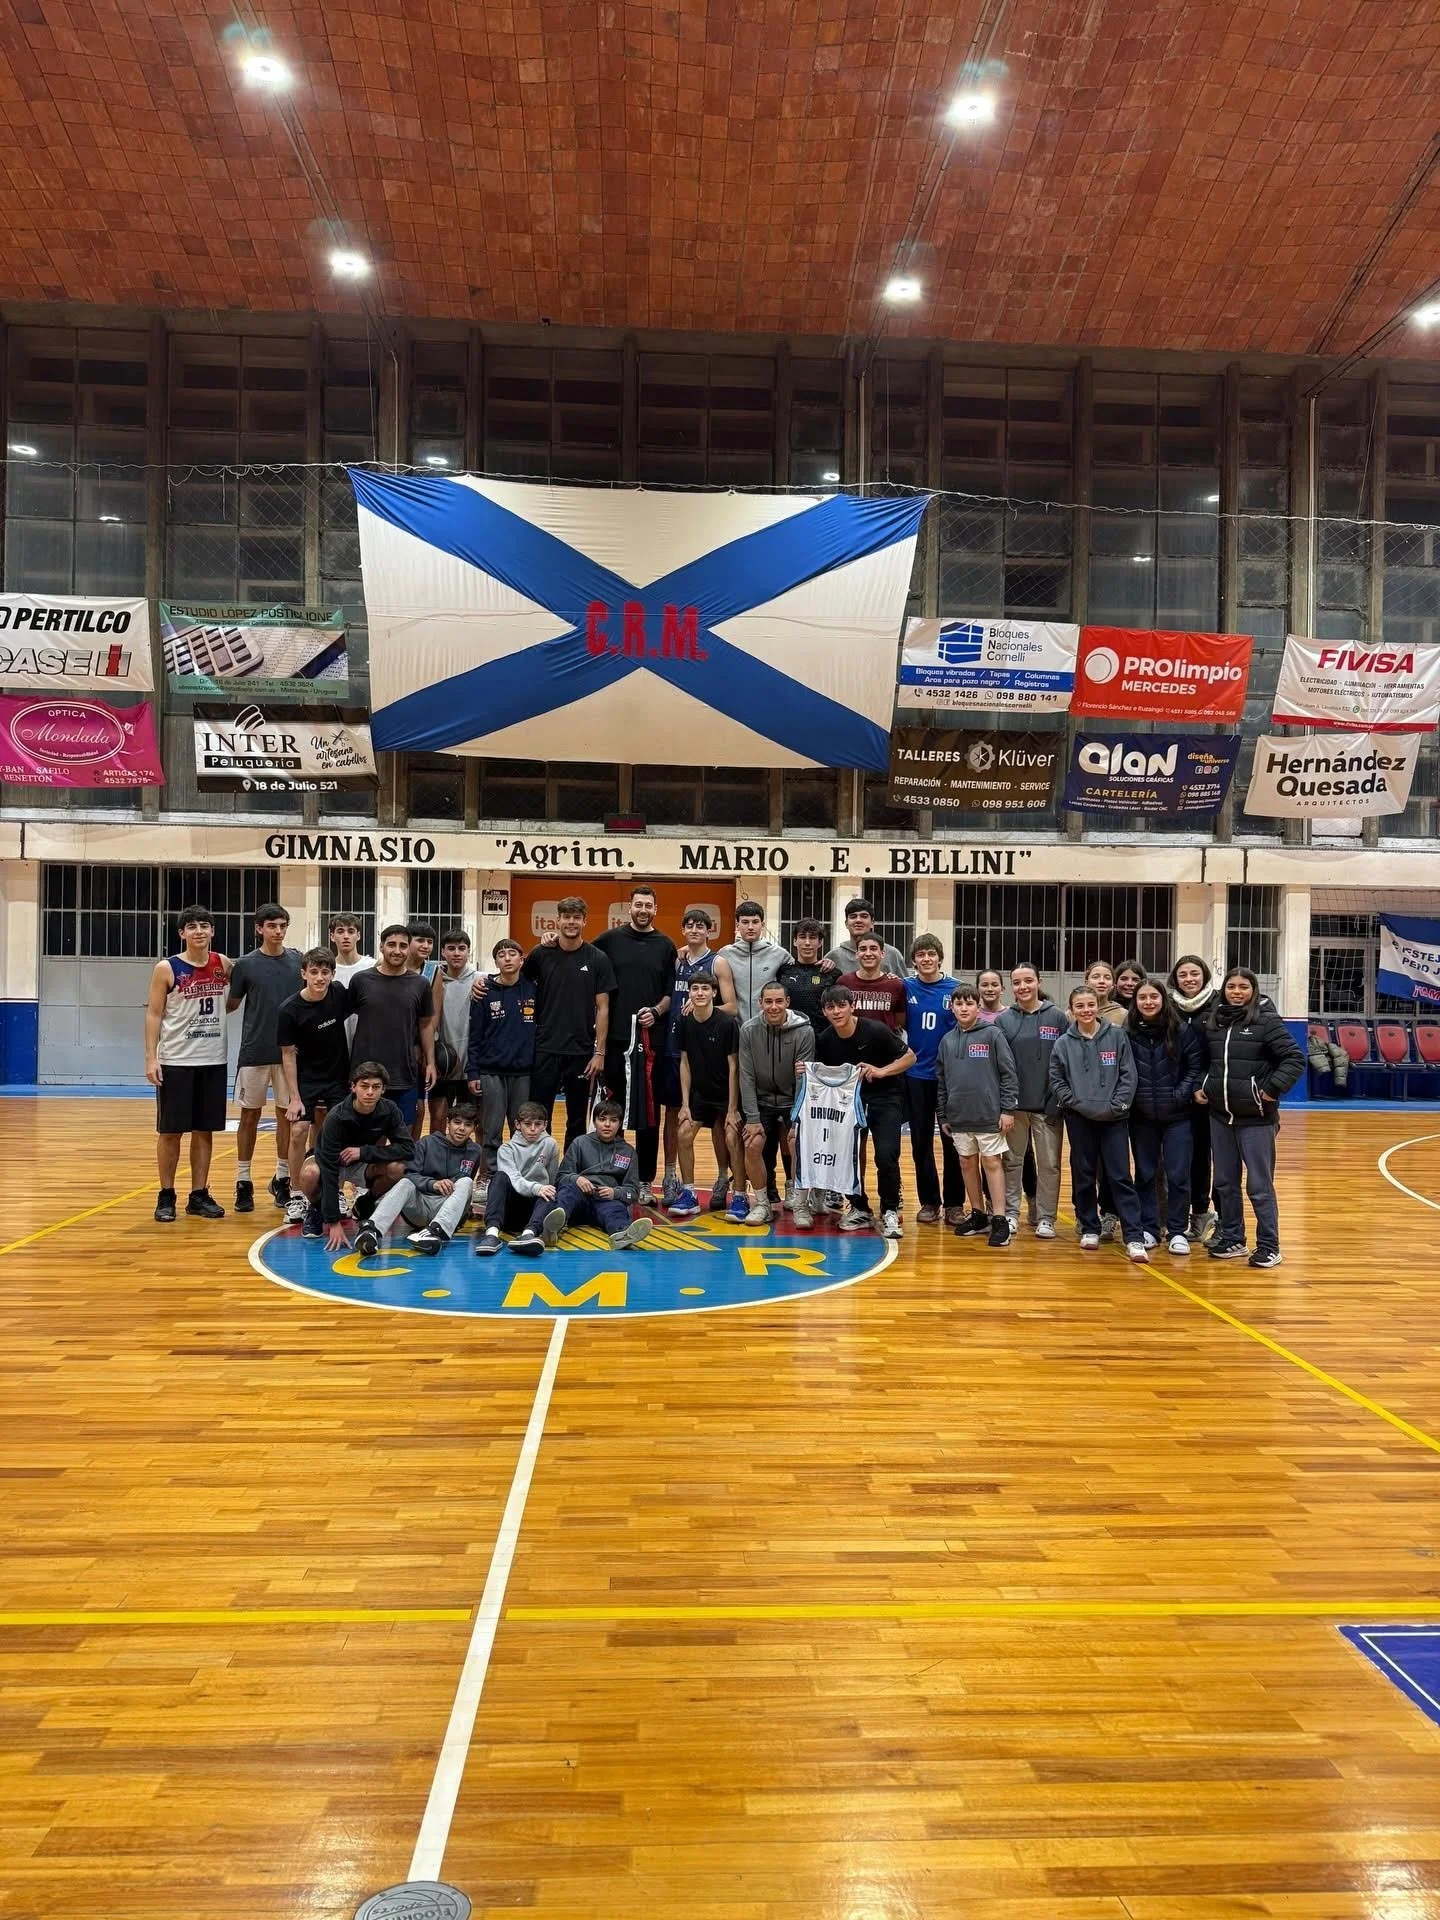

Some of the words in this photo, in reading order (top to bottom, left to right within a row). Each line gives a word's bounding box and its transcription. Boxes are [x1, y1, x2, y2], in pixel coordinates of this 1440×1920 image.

[12, 607, 132, 634] PERTILCO
[169, 605, 218, 618] ESTUDIO
[261, 607, 333, 622] POSTIGIONE
[989, 627, 1030, 642] Bloques
[988, 640, 1043, 652] Nacionales
[987, 651, 1026, 662] Cornelli
[1317, 649, 1414, 674] FIVISA
[915, 667, 944, 677] Bloques
[945, 668, 976, 677] vibrados
[1024, 672, 1060, 681] Columnas
[1123, 656, 1243, 685] PROlimpio
[924, 676, 942, 684] Aros
[943, 678, 960, 686] para
[980, 679, 1001, 687] negro
[1014, 680, 1050, 688] Registros
[1121, 679, 1198, 695] MERCEDES
[1300, 676, 1338, 686] ELECTRICIDAD
[926, 689, 951, 698] 4532
[954, 690, 978, 699] 1426
[996, 692, 1014, 700] 098
[1017, 693, 1037, 702] 880
[1040, 694, 1058, 702] 141
[1308, 687, 1334, 695] MOTORES
[1082, 702, 1108, 710] Florencio
[1108, 703, 1132, 711] Sánchez
[48, 709, 87, 719] OPTICA
[21, 722, 111, 744] Mondada
[202, 732, 301, 754] INTER
[310, 735, 330, 750] Un
[321, 760, 334, 770] en
[897, 749, 961, 763] TALLERES
[998, 749, 1055, 767] Klüver
[1266, 750, 1407, 774] Hernández
[36, 766, 70, 775] SAFILO
[103, 769, 138, 777] ARTIGAS
[4, 773, 53, 783] BENETTON
[894, 776, 941, 788] REPARACIÓN
[950, 780, 1011, 790] MANTENIMIENTO
[1020, 782, 1051, 790] SERVICE
[1146, 775, 1174, 783] GRÁFICAS
[1276, 773, 1388, 797] Quesada
[255, 781, 268, 791] 18
[270, 781, 285, 791] de
[288, 781, 317, 791] Julio
[320, 781, 338, 790] 521
[1085, 787, 1158, 799] CARTELERÍA
[903, 795, 930, 806] 4533
[932, 797, 960, 807] 0850
[982, 799, 1002, 809] 098
[1005, 799, 1024, 809] 951
[1027, 799, 1047, 808] 606
[265, 834, 436, 863] GIMNASIO
[680, 845, 789, 872] MARIO
[830, 847, 850, 873] E
[199, 997, 214, 1015] 18
[853, 1000, 891, 1011] AINING
[921, 1012, 937, 1030] 10
